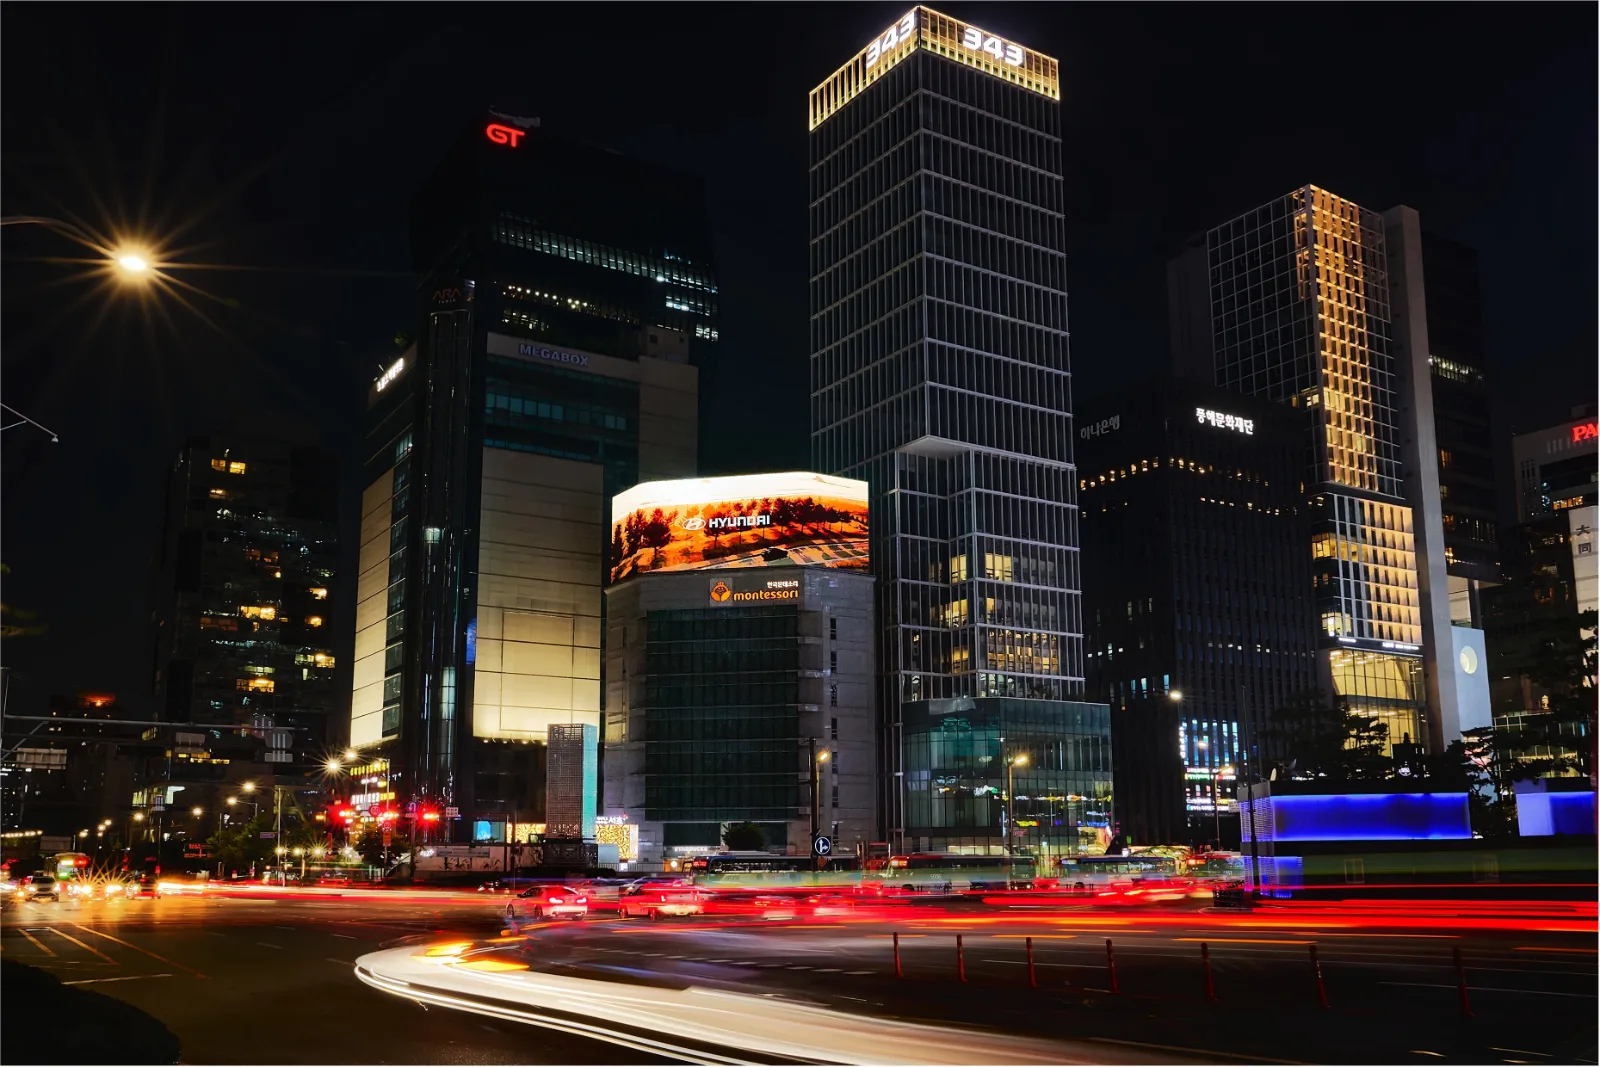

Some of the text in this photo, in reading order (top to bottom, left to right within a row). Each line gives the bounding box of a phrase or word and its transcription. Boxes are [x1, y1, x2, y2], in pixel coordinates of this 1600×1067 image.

[866, 11, 916, 68] 343
[963, 27, 1025, 67] 343
[486, 124, 525, 148] GT
[432, 288, 461, 300] ARA
[519, 343, 589, 367] MEGABOX
[1080, 414, 1120, 440] 하나은행
[1572, 423, 1598, 442] PA
[709, 515, 770, 528] HYUNDAI
[733, 590, 799, 601] montessori
